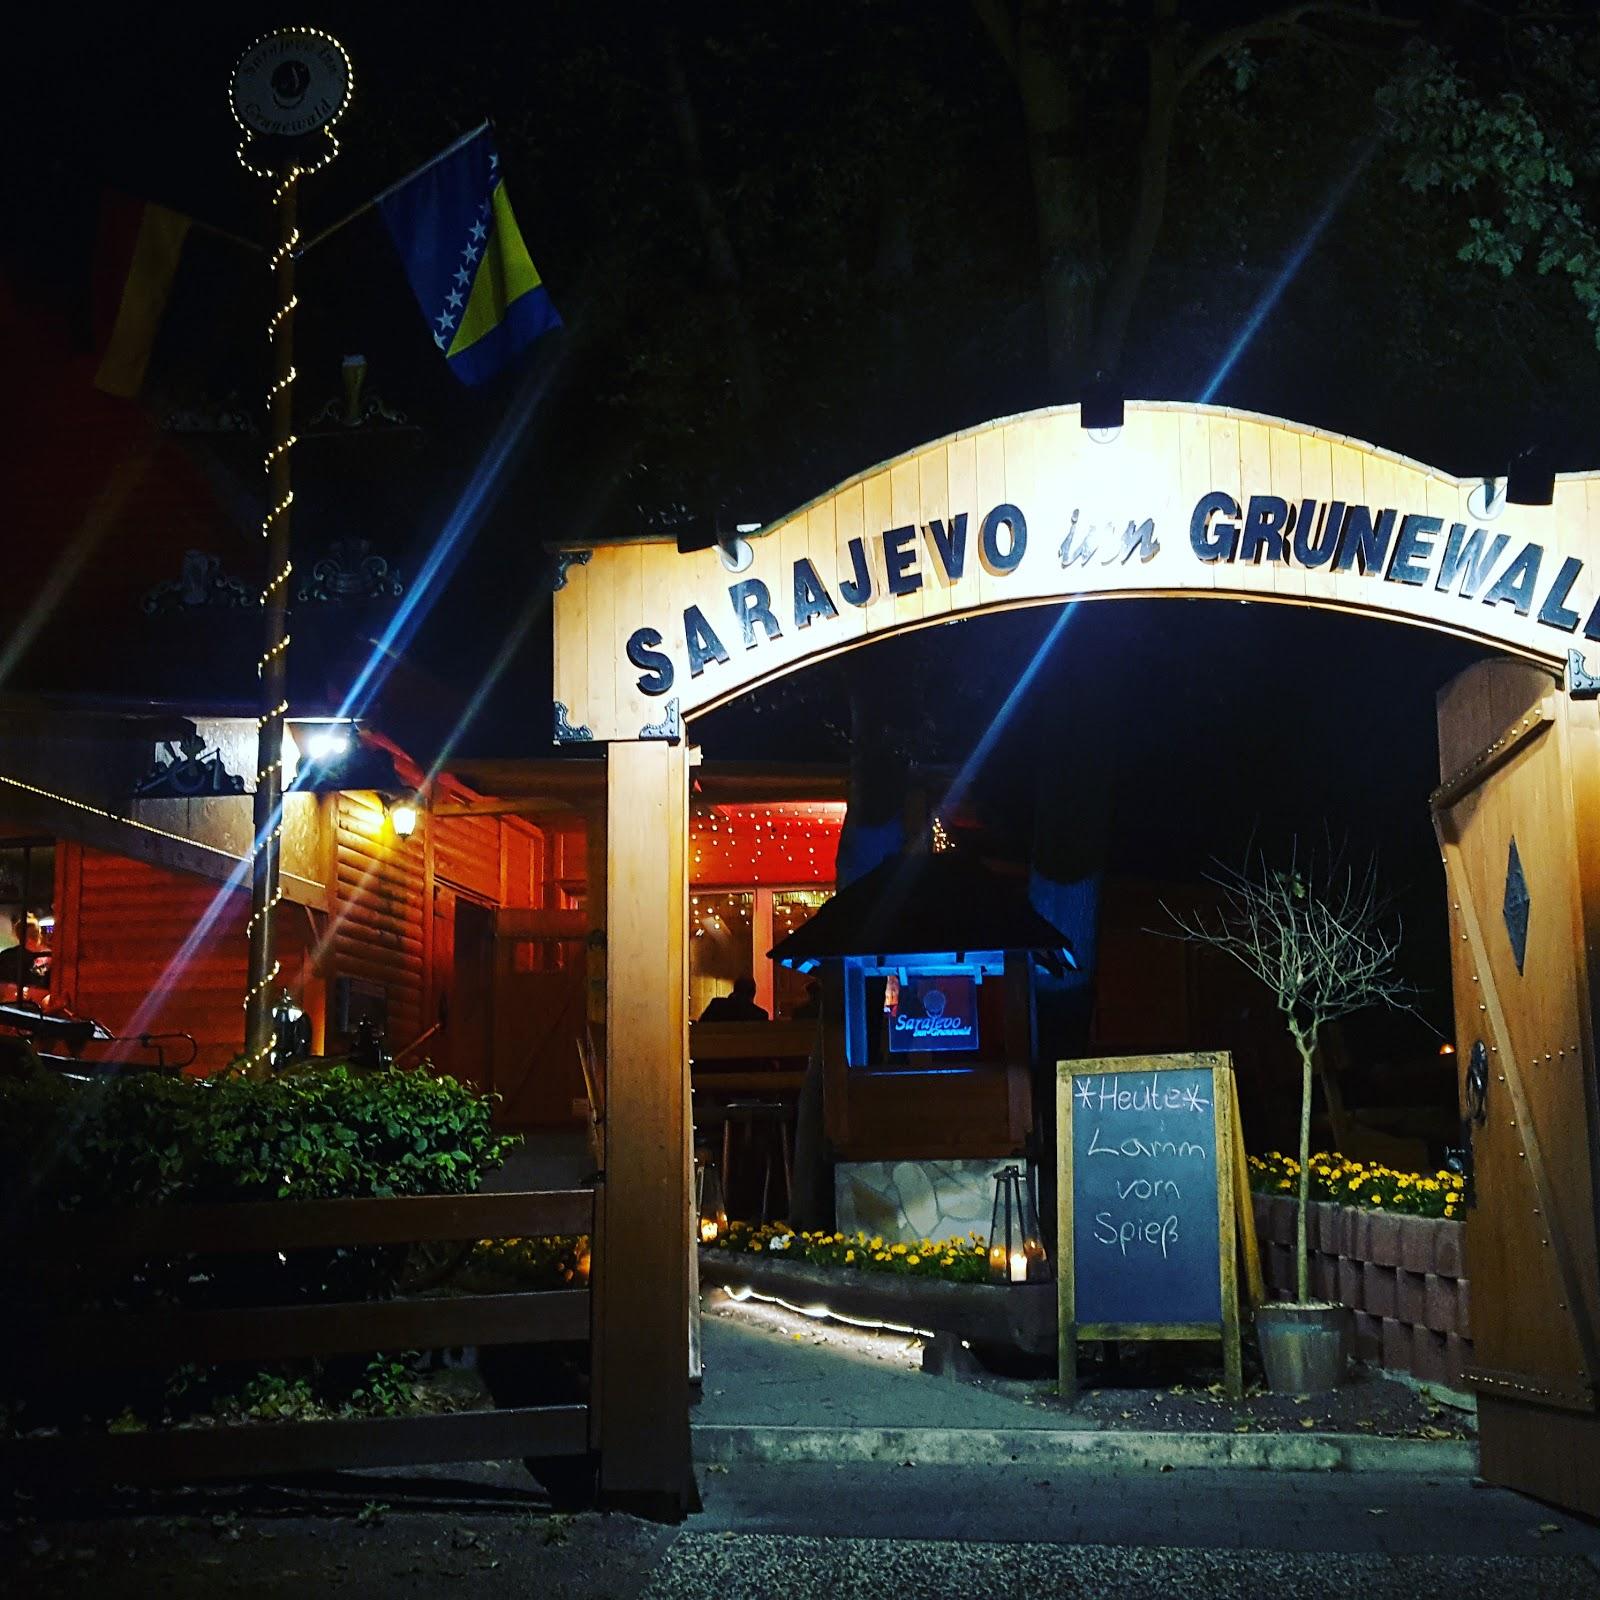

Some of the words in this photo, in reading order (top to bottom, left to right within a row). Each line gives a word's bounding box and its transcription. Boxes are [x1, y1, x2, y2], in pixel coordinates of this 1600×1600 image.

[625, 503, 1028, 695] SARAJEVO
[895, 1014, 961, 1034] Sarajevo
[1088, 1128, 1206, 1160] Lamm
[1094, 1212, 1179, 1259] Spieß
